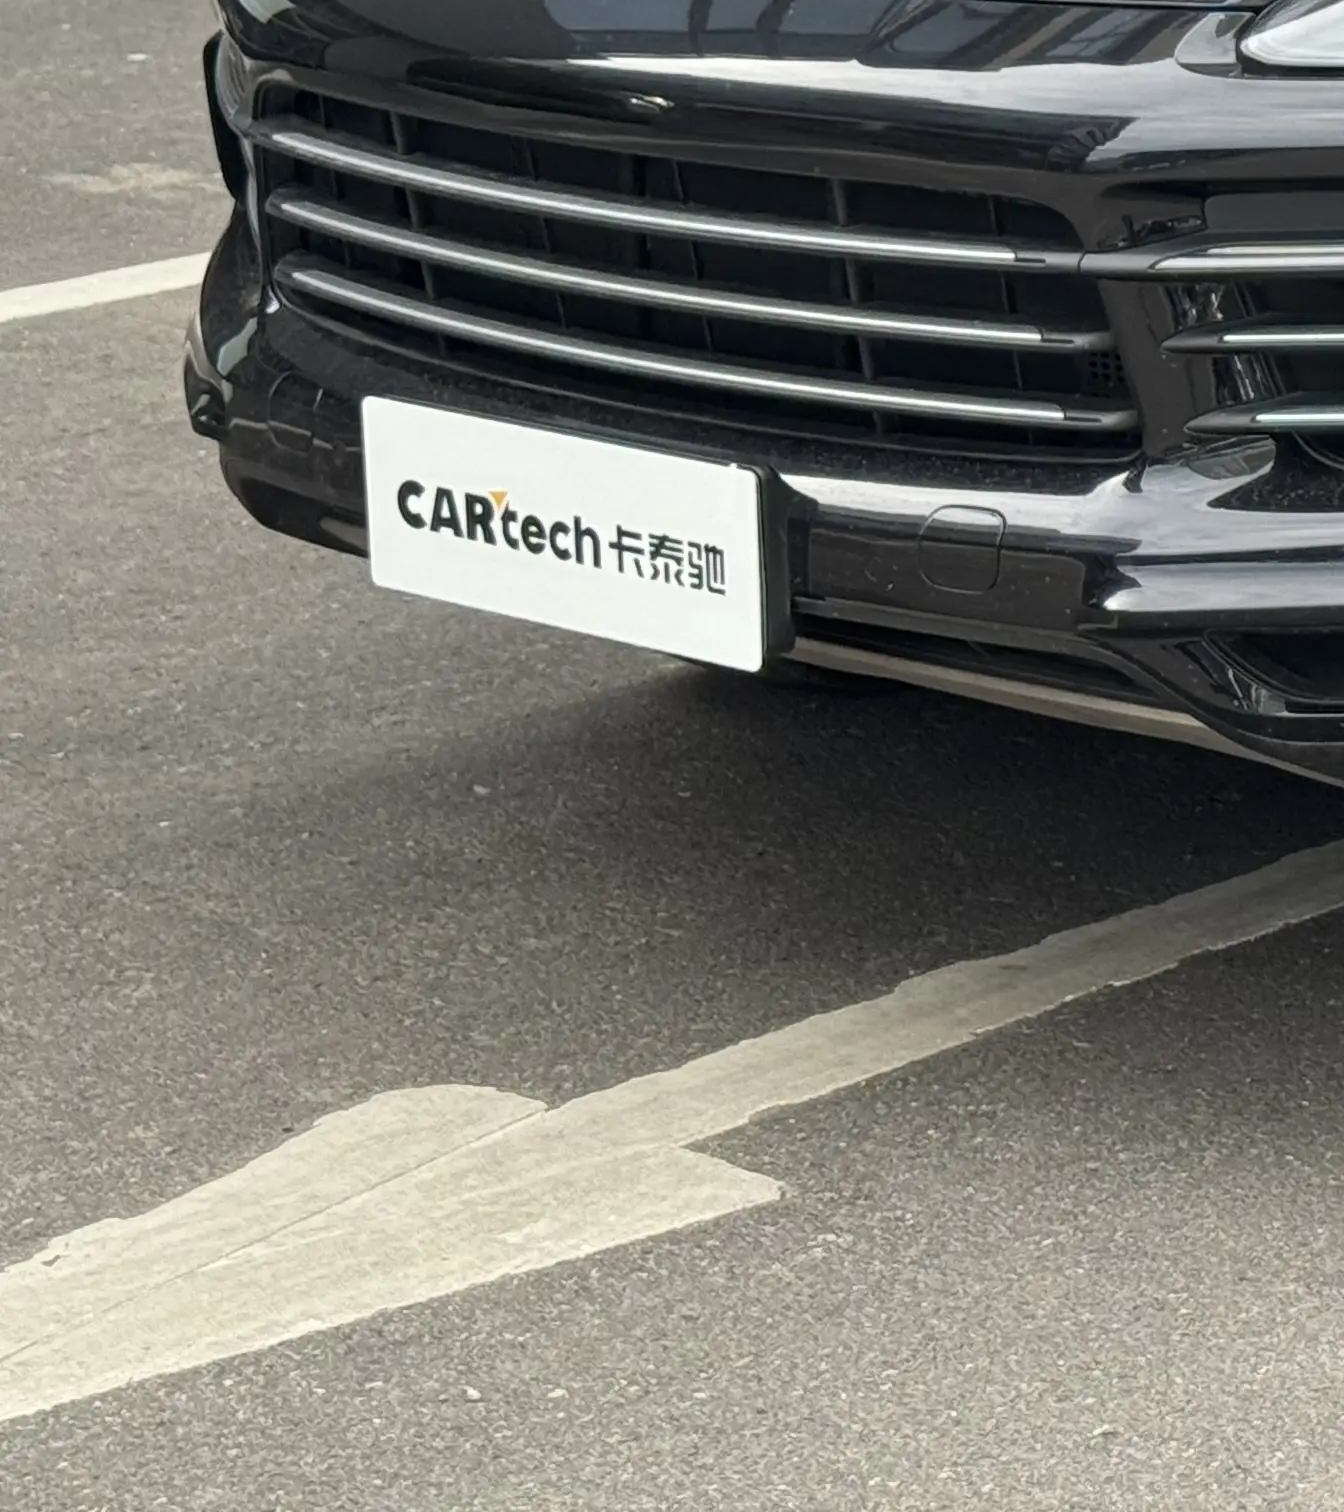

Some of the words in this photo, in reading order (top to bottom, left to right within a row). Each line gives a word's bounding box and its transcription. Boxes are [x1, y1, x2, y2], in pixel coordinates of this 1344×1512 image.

[397, 479, 602, 569] CARtech
[608, 524, 727, 596] 卡泰驰
